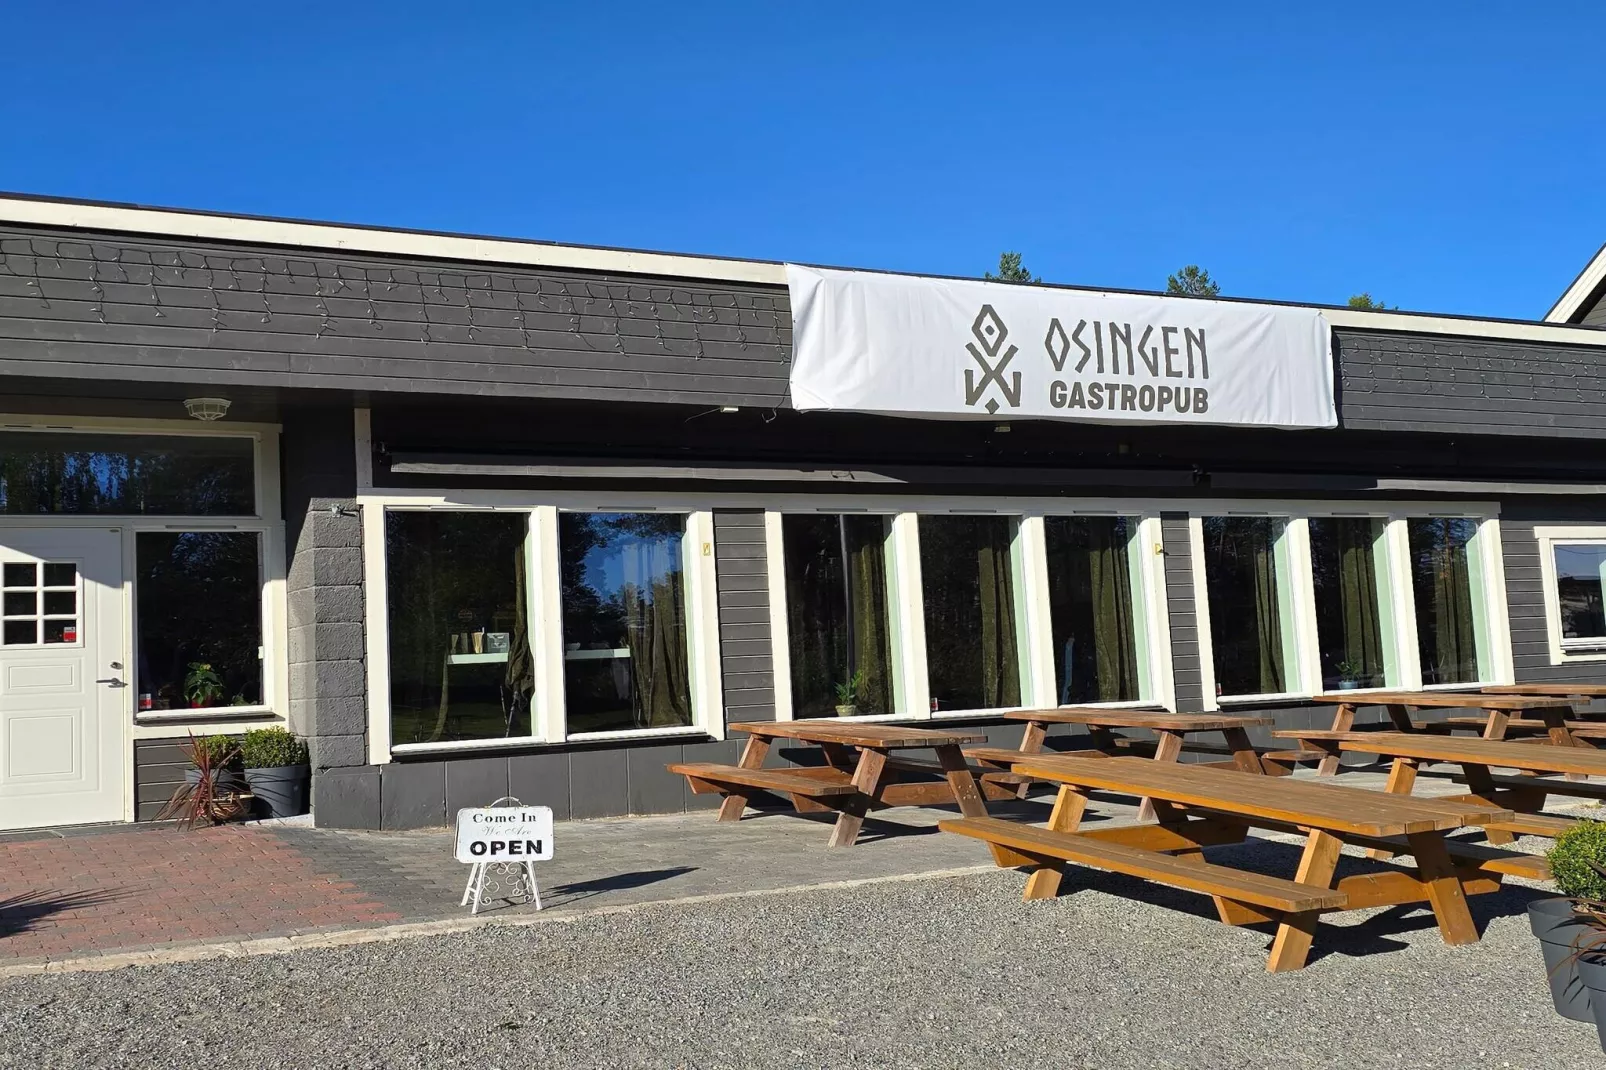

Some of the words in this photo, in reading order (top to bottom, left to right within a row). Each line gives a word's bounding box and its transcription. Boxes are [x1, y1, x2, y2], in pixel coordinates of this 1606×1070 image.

[1045, 318, 1209, 379] OSINGEN
[1050, 380, 1208, 413] GASTROPUB
[473, 813, 516, 823] Come
[521, 813, 537, 822] In
[482, 826, 501, 836] We
[470, 840, 543, 855] OPEN
